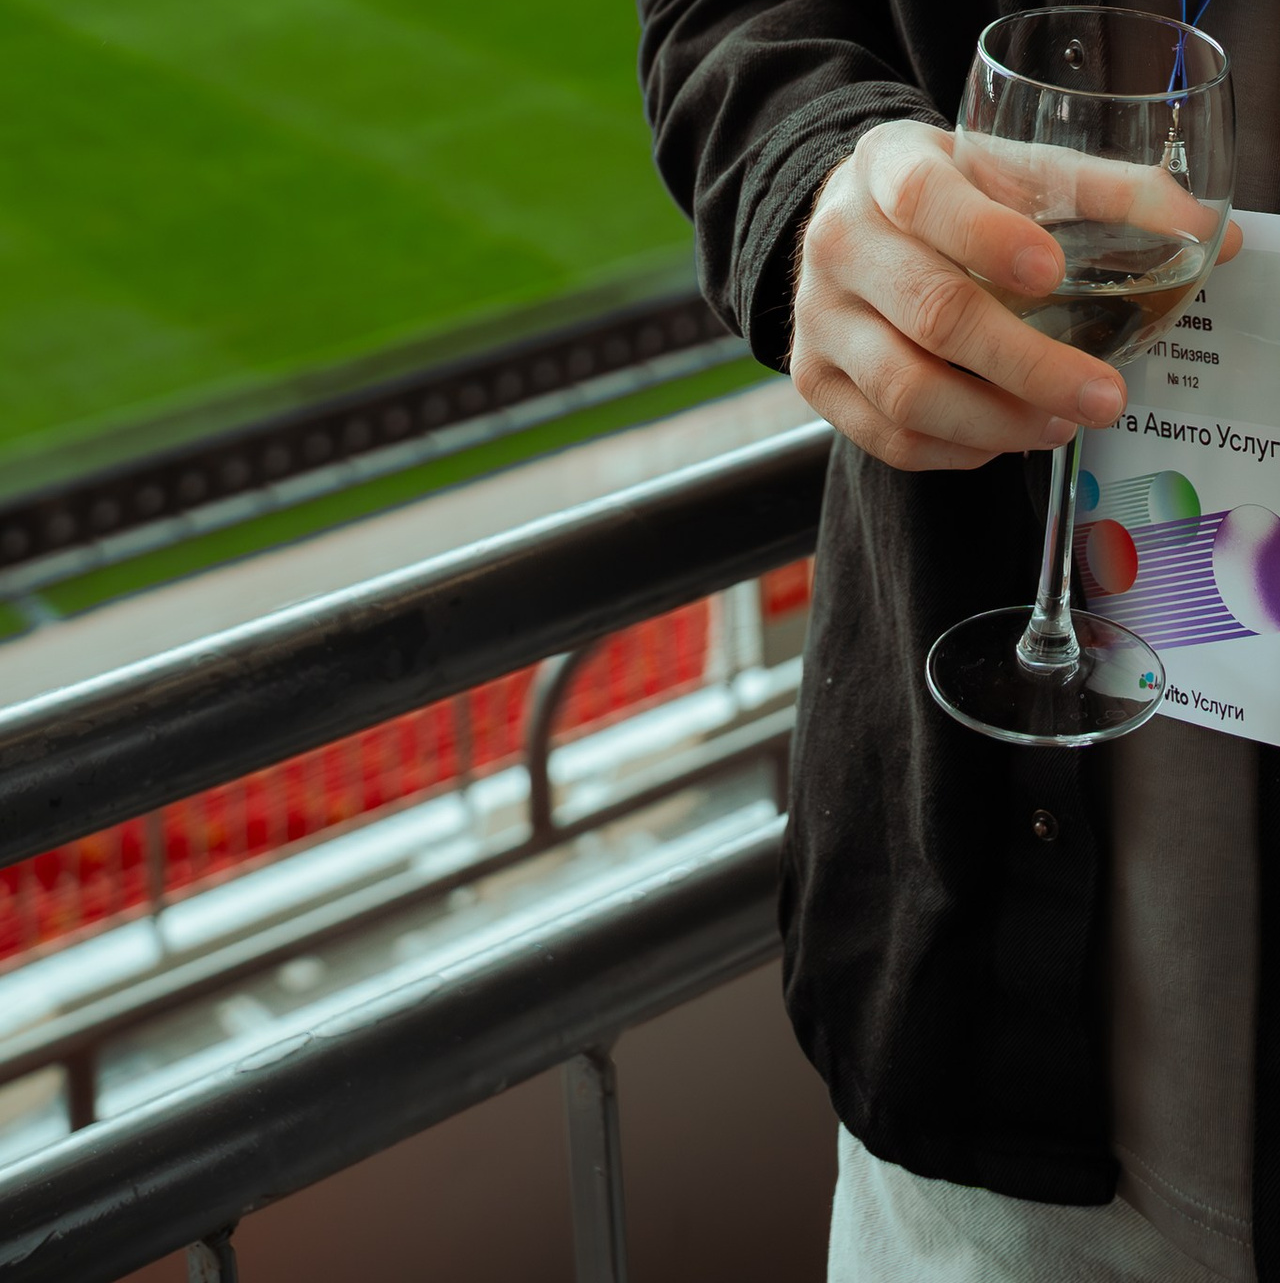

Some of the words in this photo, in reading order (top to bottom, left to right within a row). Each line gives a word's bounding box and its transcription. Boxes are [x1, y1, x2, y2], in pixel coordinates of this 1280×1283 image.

[1147, 341, 1167, 357] ИП
[1171, 343, 1219, 365] Бизяев
[1167, 372, 1179, 385] №
[1182, 375, 1199, 389] 112
[1111, 414, 1138, 433] га
[1144, 412, 1211, 446] Авито
[1216, 424, 1280, 462] Услуг
[1191, 689, 1244, 722] Услуги
